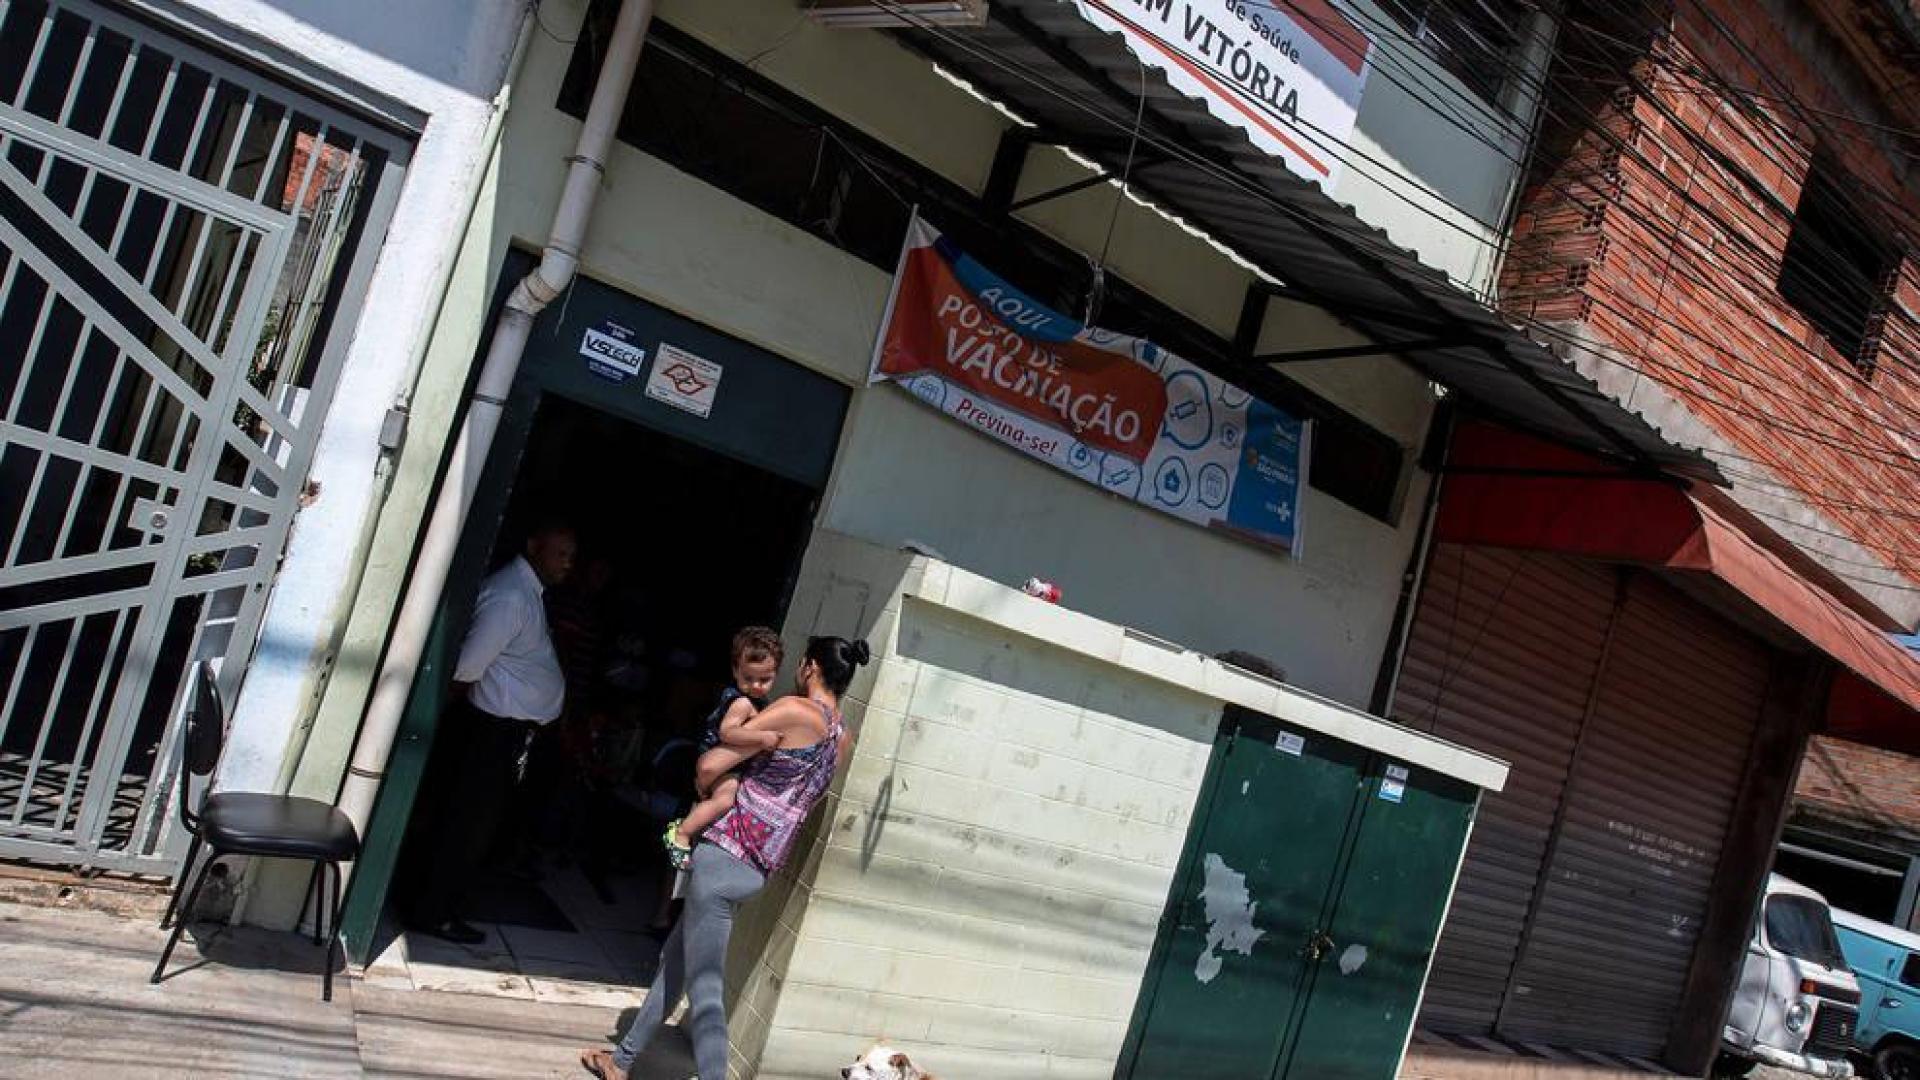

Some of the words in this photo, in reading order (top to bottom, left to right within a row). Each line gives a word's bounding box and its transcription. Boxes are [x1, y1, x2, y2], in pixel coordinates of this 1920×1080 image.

[1133, 0, 1173, 23] M
[1184, 3, 1300, 122] VITÓRIA
[1250, 13, 1300, 65] Saúde
[980, 288, 1053, 330] AQUI
[955, 397, 1058, 457] Previna-se!
